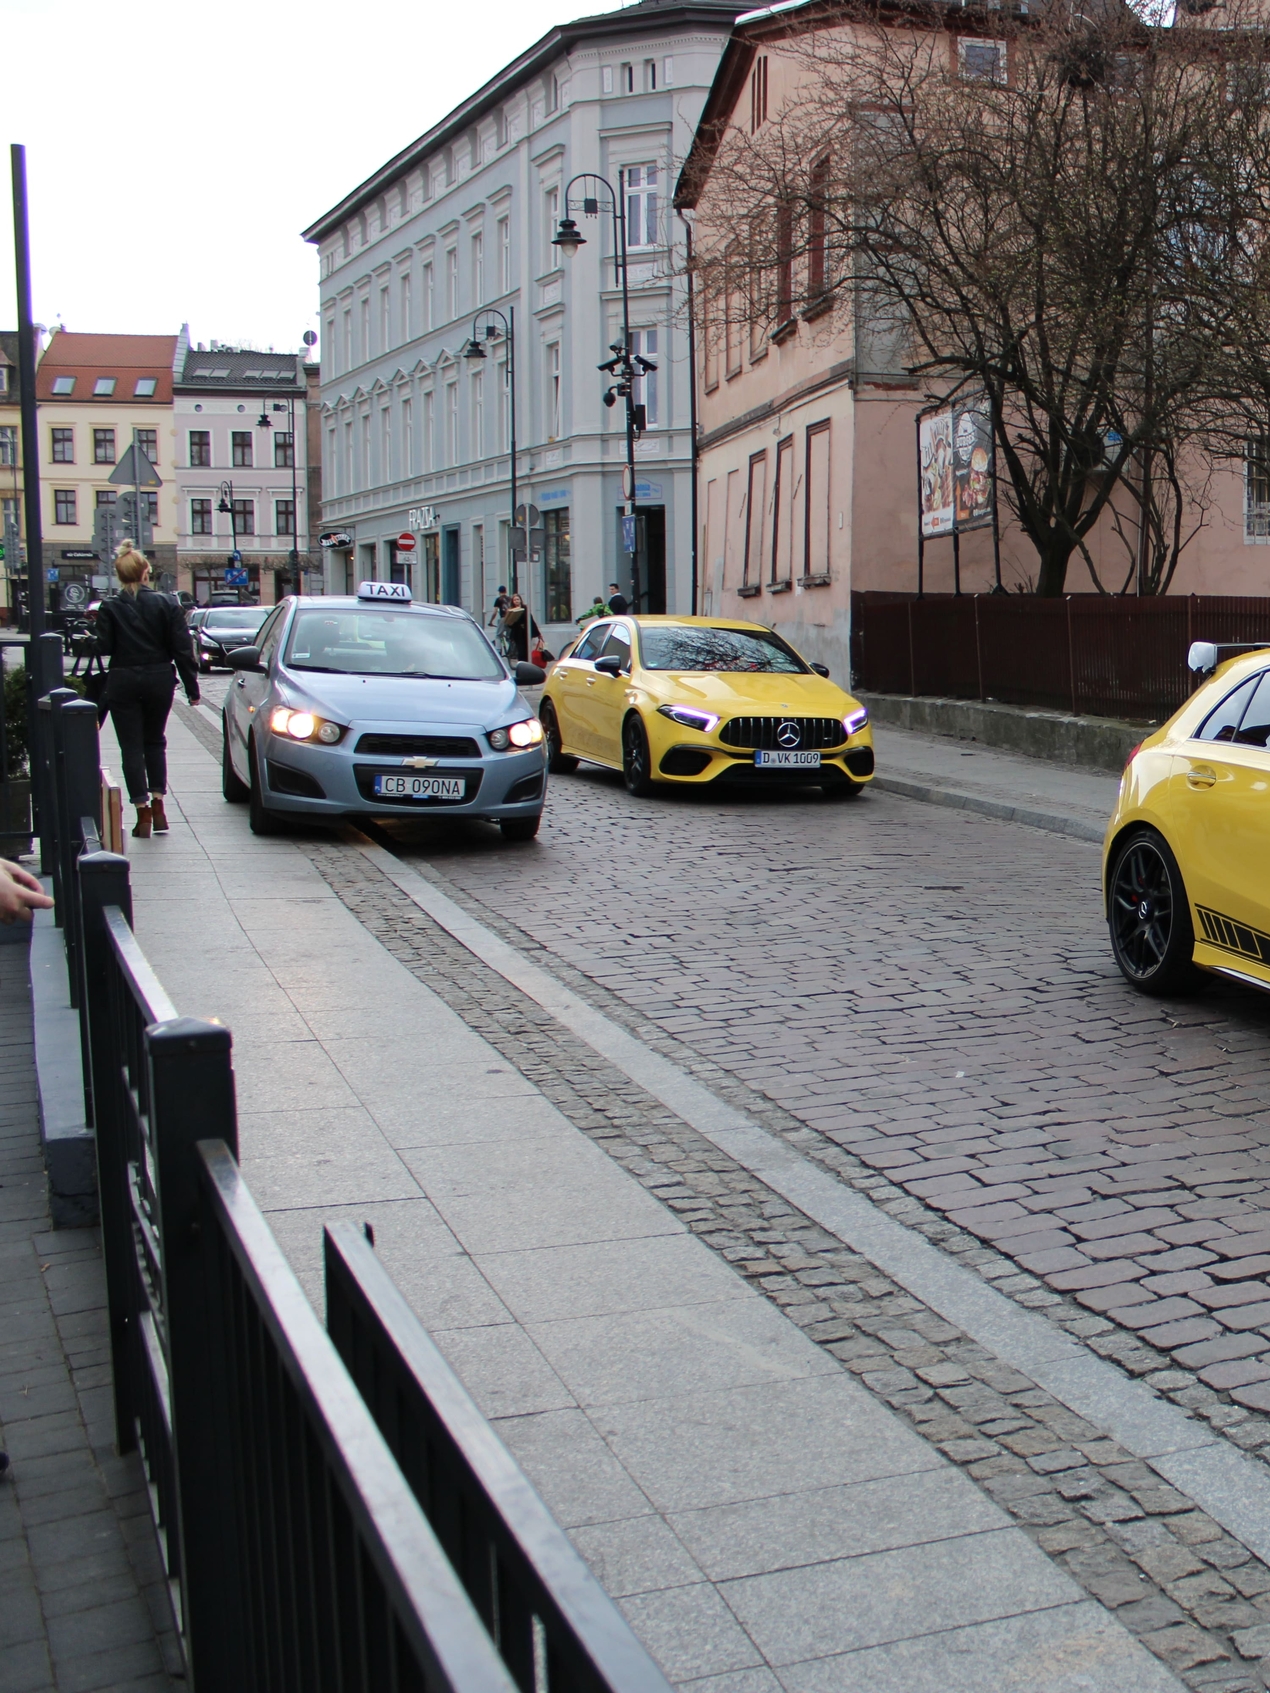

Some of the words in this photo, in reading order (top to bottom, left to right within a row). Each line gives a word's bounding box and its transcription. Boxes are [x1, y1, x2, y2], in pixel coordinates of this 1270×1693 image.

[366, 583, 406, 598] TAXI
[762, 752, 770, 764] D
[777, 752, 792, 764] VK
[793, 752, 819, 764] 1009
[385, 777, 406, 793] CB
[412, 778, 461, 795] 090NA
